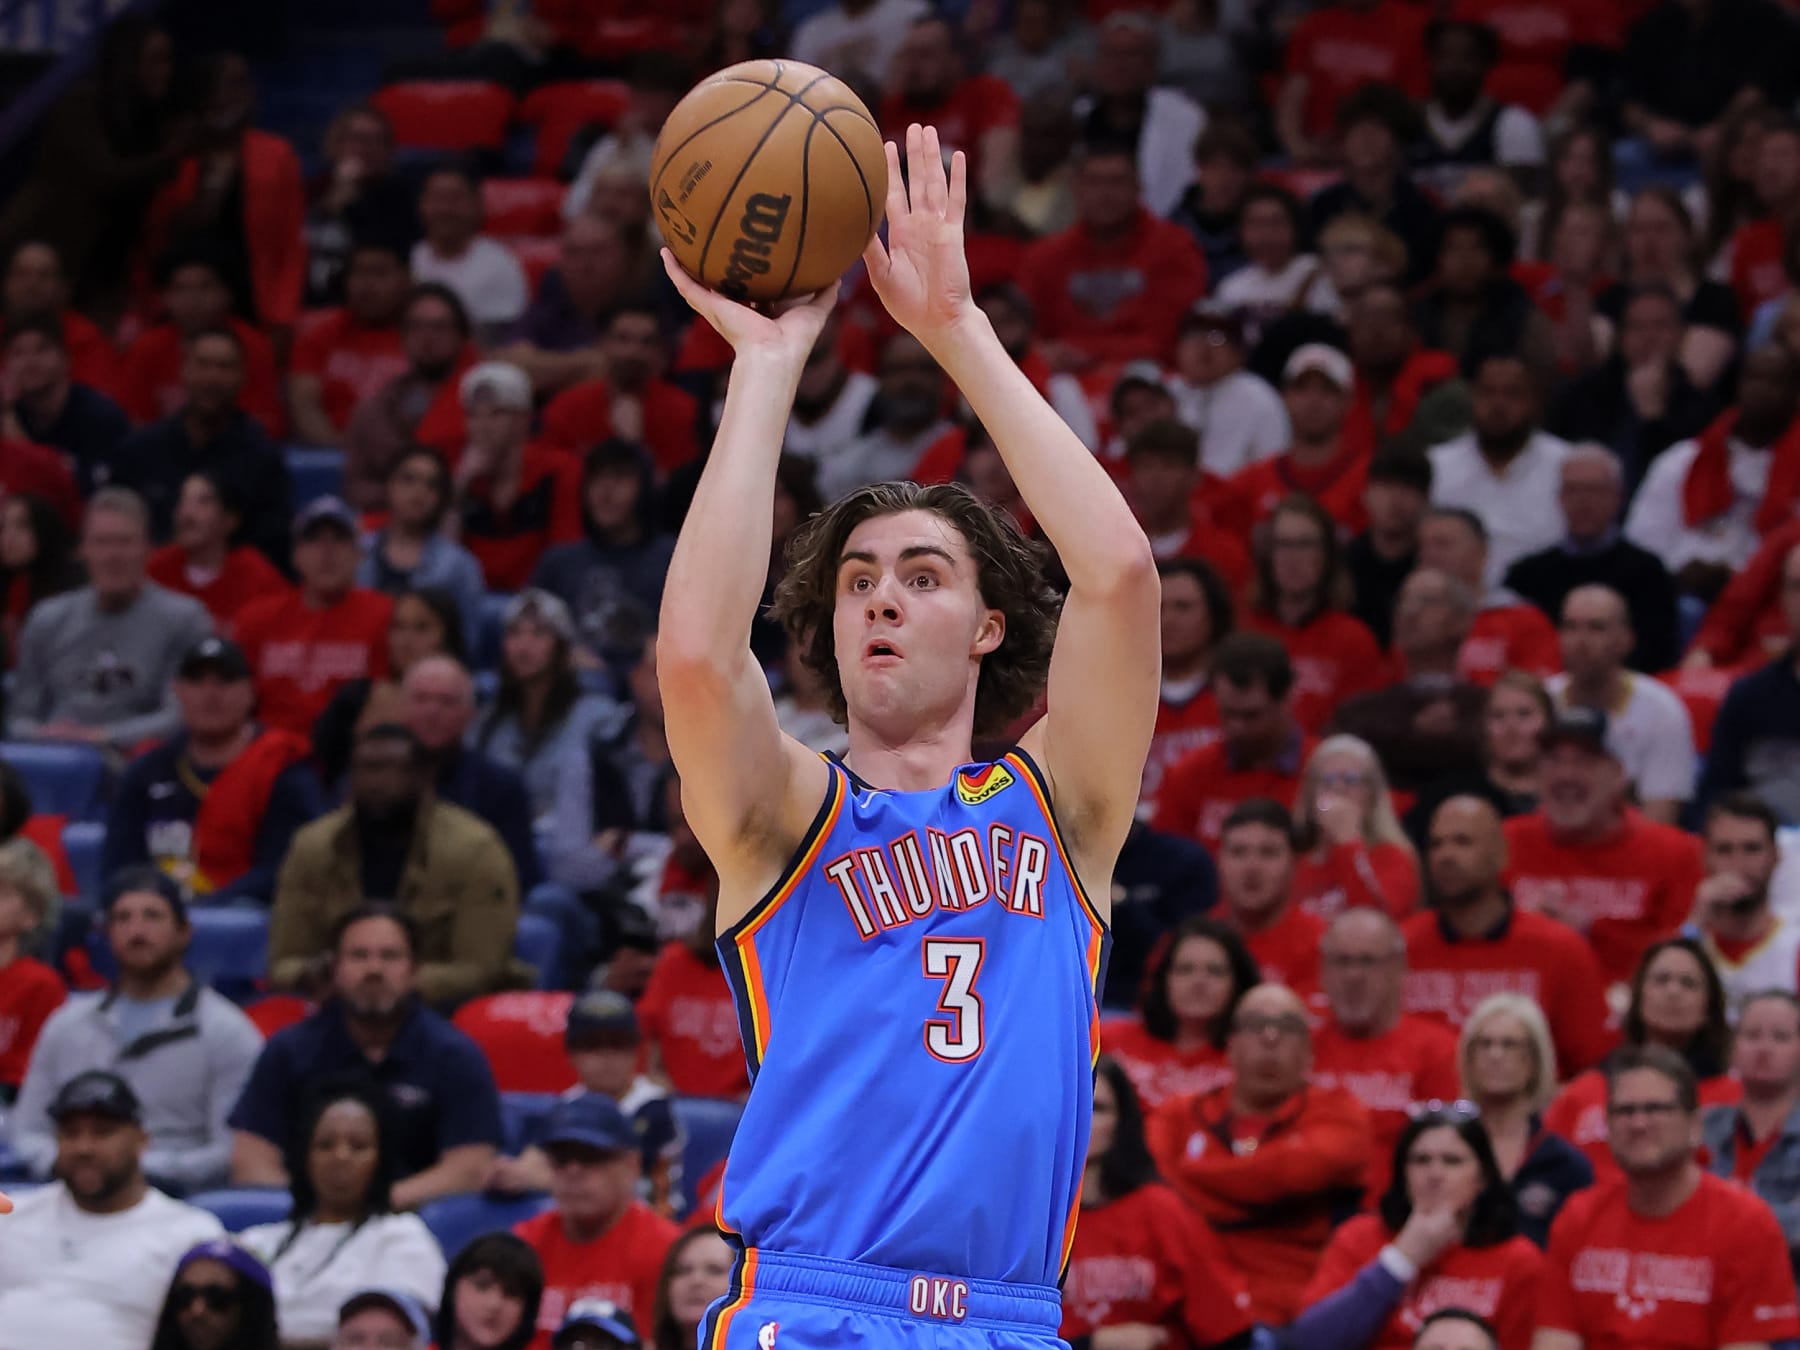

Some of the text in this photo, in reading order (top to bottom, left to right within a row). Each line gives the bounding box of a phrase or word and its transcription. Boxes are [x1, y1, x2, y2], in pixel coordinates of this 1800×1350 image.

[720, 192, 792, 300] Wilso
[823, 822, 1050, 942] THUNDER
[922, 935, 986, 1064] 3
[910, 1275, 969, 1321] OKC
